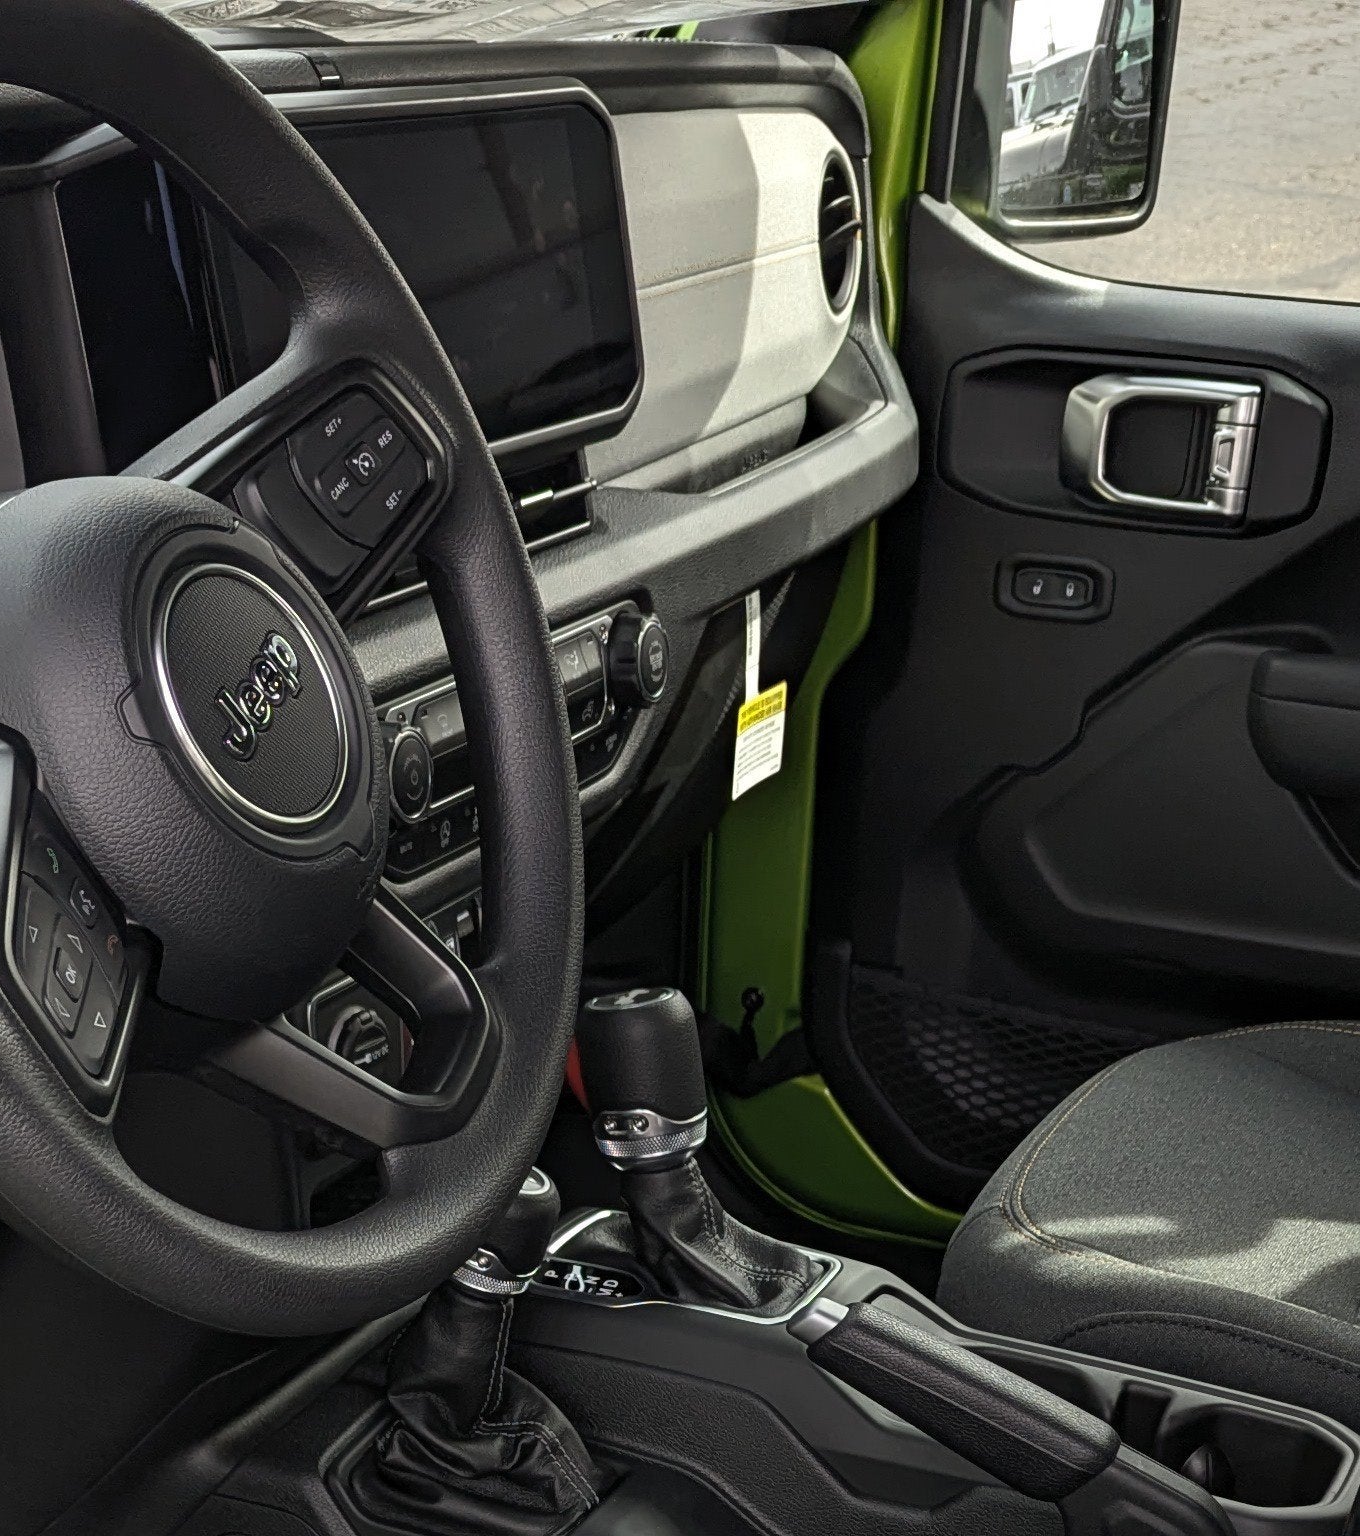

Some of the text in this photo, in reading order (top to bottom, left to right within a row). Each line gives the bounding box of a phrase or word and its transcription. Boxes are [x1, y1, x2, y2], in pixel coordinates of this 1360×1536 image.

[377, 430, 393, 448] RES
[330, 477, 350, 500] CANC
[215, 631, 302, 761] Jeep
[65, 963, 77, 985] OK
[544, 1269, 559, 1279] P
[602, 1279, 619, 1289] D
